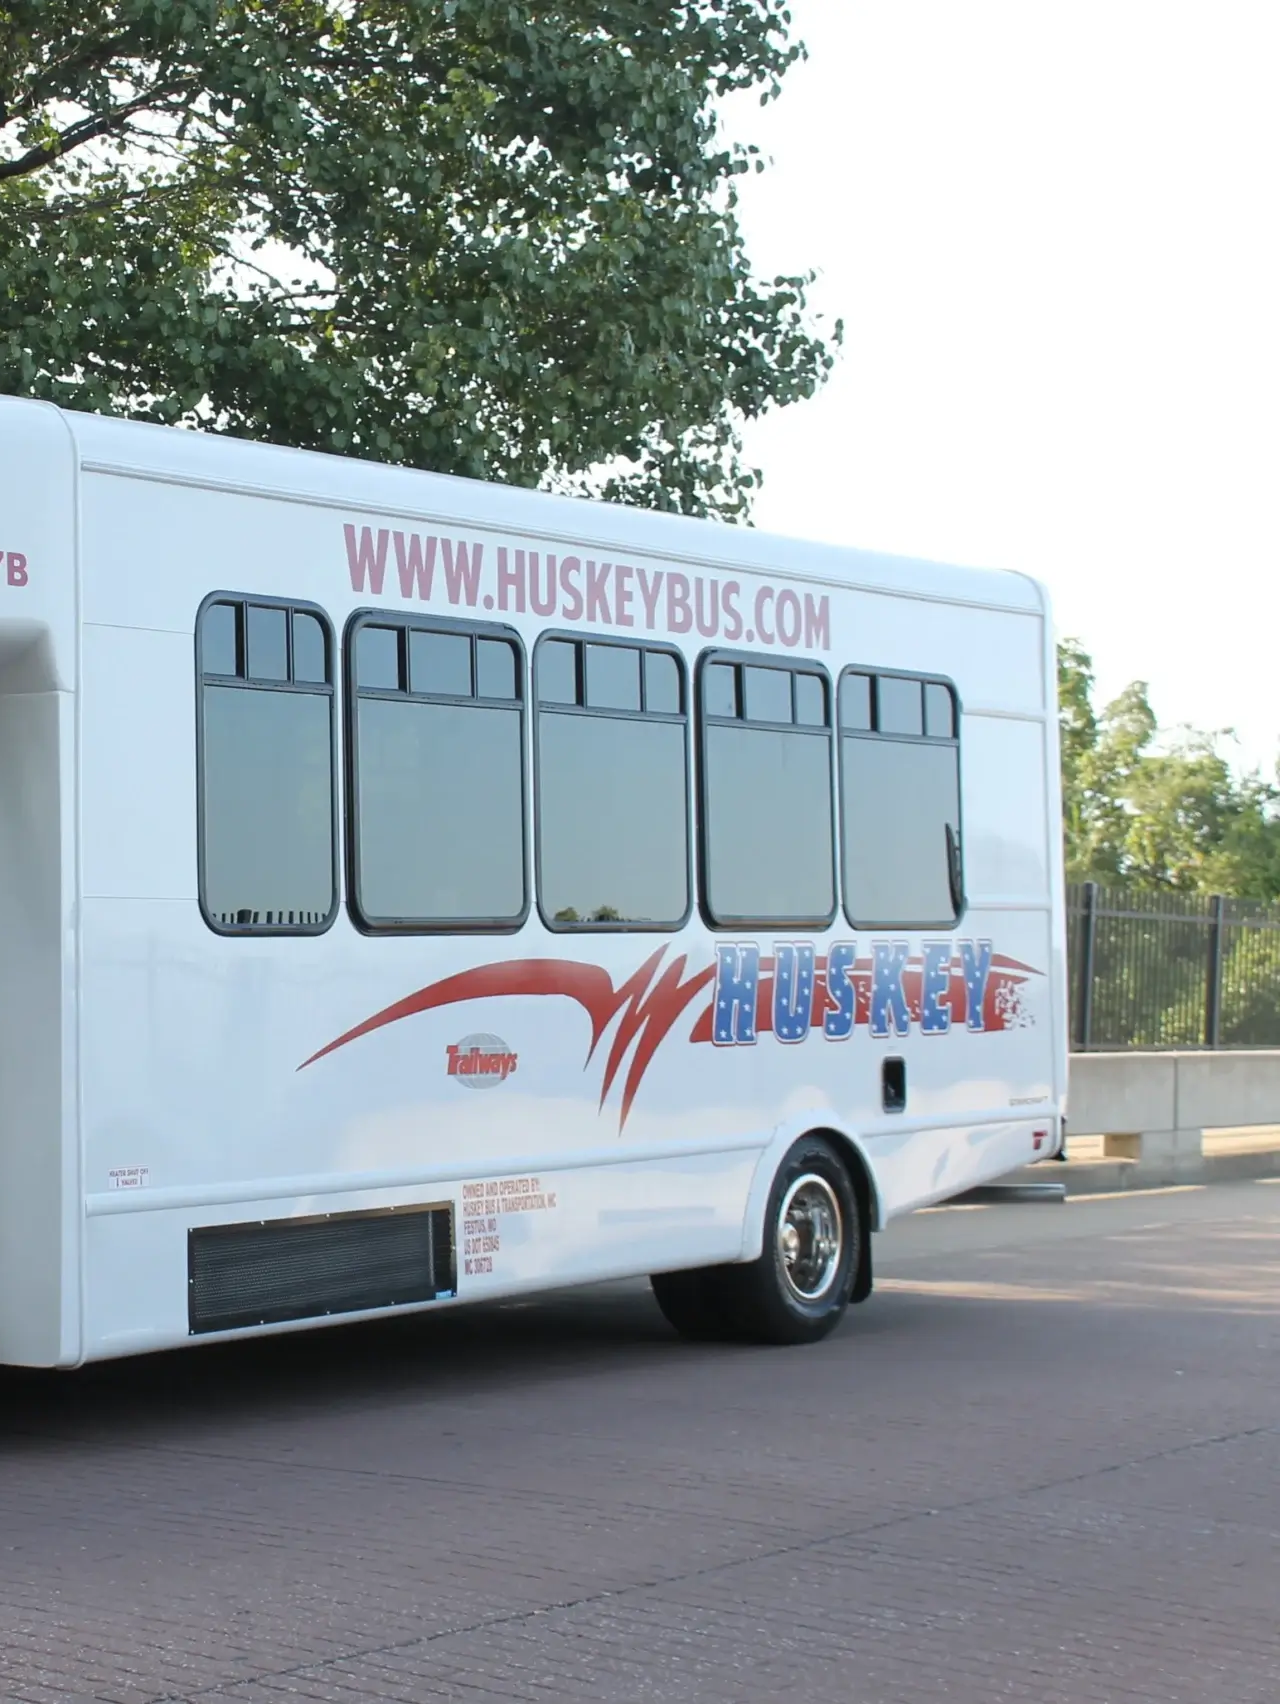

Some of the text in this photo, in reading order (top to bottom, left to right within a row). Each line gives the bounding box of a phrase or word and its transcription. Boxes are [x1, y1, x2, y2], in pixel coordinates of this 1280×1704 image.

[343, 523, 832, 651] WWW.HUSKEYBUS.COM
[712, 939, 993, 1045] HUSKEY
[446, 1044, 518, 1080] Trailways
[463, 1183, 484, 1199] OWNED
[486, 1181, 498, 1196] AND
[500, 1179, 529, 1196] OPERATED
